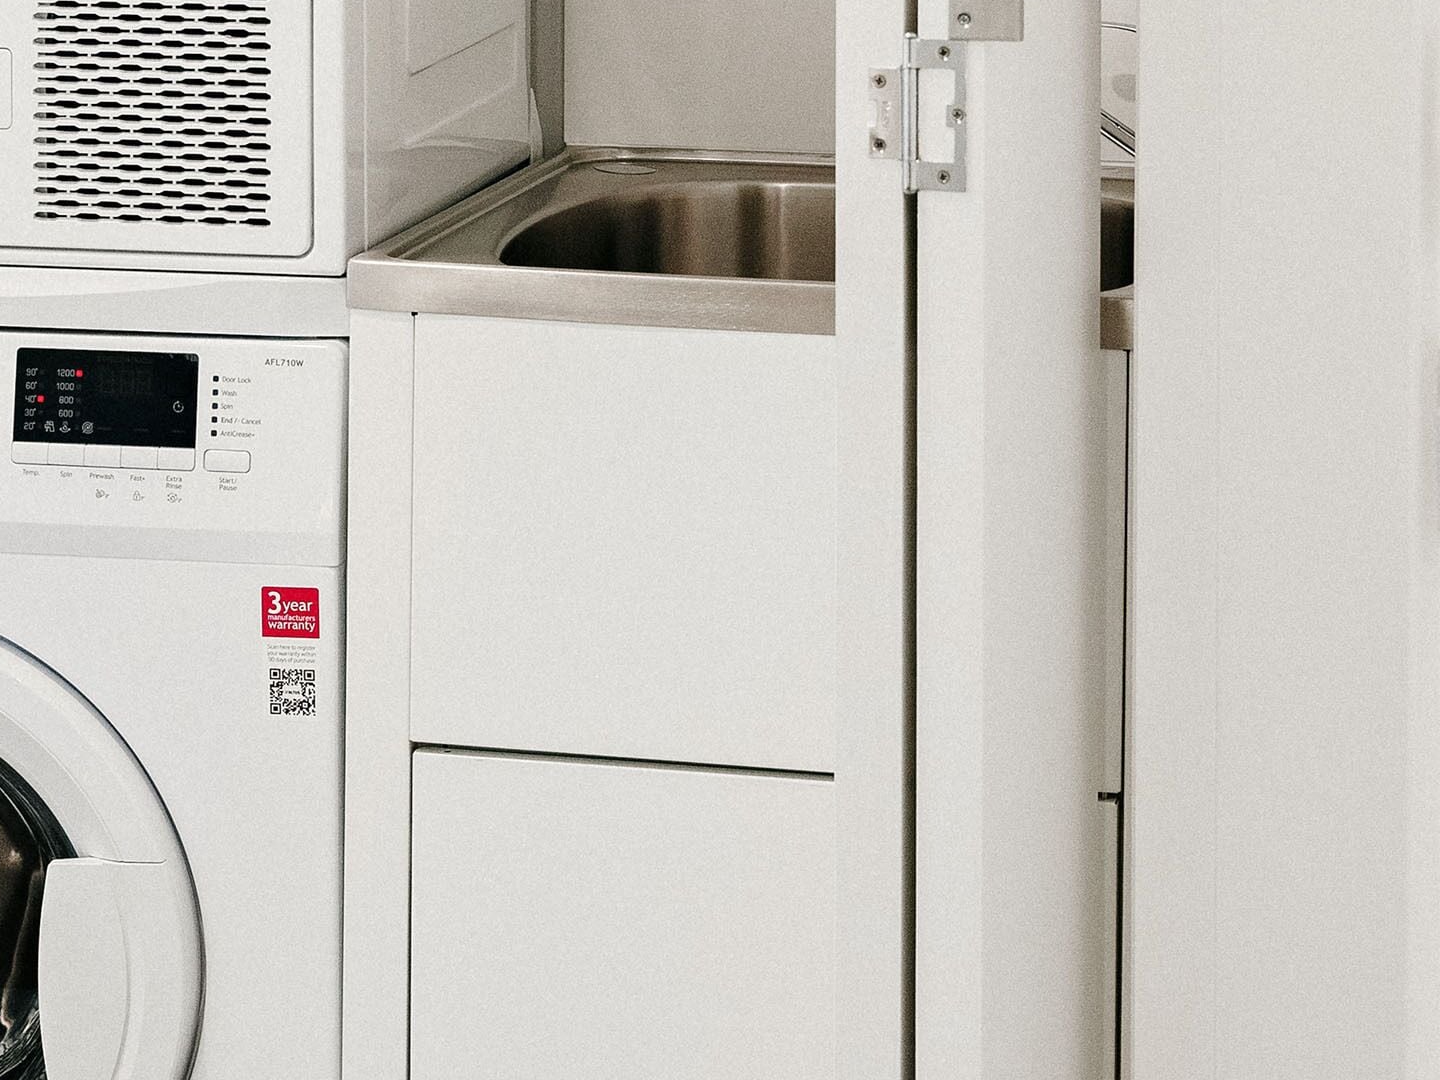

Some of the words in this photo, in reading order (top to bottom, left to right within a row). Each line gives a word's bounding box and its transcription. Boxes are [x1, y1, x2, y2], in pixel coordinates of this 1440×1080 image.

[264, 358, 304, 367] AFL710W
[56, 368, 76, 378] 1200
[222, 375, 236, 383] Door
[237, 376, 252, 384] Lock
[56, 382, 75, 391] 1000
[58, 409, 74, 418] 600
[59, 470, 73, 478] Spin
[89, 472, 115, 480] Prewash
[166, 475, 183, 483] Extra
[166, 482, 182, 490] Rinse
[219, 484, 238, 492] Pause
[267, 591, 282, 615] 3
[282, 601, 313, 615] year
[267, 614, 316, 622] manufacturers
[267, 621, 316, 633] warranty
